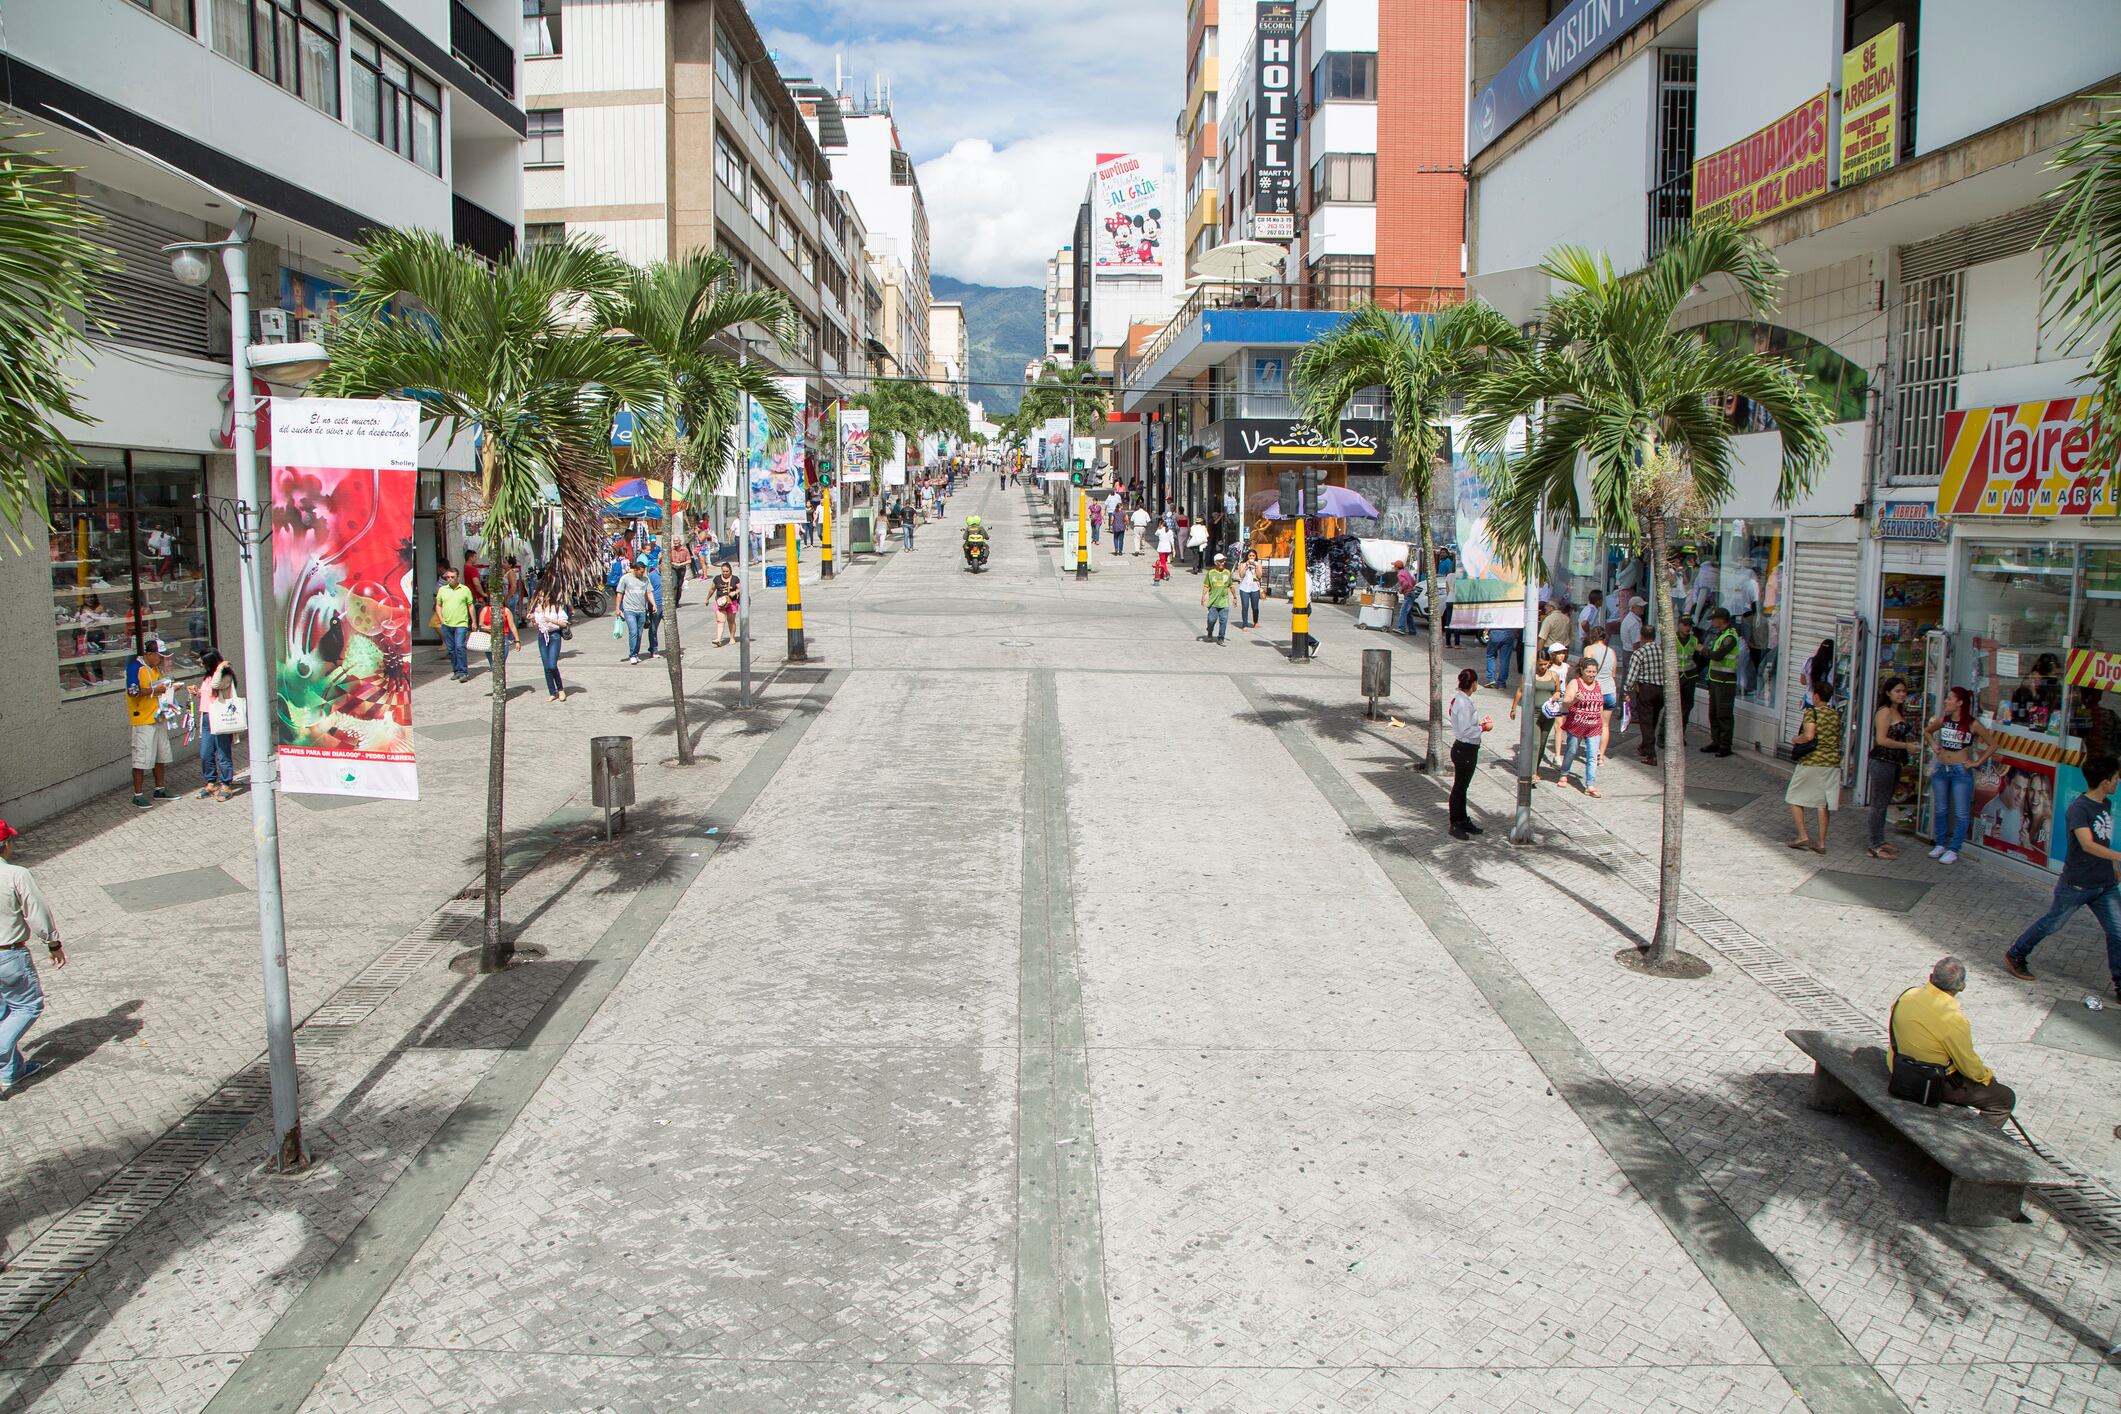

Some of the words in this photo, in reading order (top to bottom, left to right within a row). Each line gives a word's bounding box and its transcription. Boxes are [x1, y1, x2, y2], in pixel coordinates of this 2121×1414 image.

[1260, 22, 1293, 30] ESCORIAL
[1545, 0, 1612, 81] MISION
[1862, 42, 1877, 73] SE
[1843, 62, 1896, 114] ARRIENDA
[1263, 39, 1290, 167] HOTEL
[1696, 98, 1825, 211] ARRENDAMOS
[1111, 178, 1156, 205] ALGRÍA
[1696, 198, 1731, 224] INFORMES
[1755, 175, 1783, 213] 402
[1785, 156, 1825, 203] 0006
[310, 412, 320, 425] Él
[333, 416, 349, 425] está
[351, 418, 380, 426] muerto:
[278, 424, 289, 433] del
[290, 425, 313, 434] sueño
[314, 425, 323, 435] de
[325, 428, 344, 436] vivir
[345, 428, 354, 436] se
[356, 426, 366, 436] ha
[368, 427, 412, 439] despertado.
[390, 459, 416, 467] Shelley
[1893, 503, 1928, 519] LIBRERÍA
[1881, 518, 1938, 539] SERVILIBROS
[281, 747, 305, 756] "CLAVES
[332, 751, 361, 759] DIALOGO"
